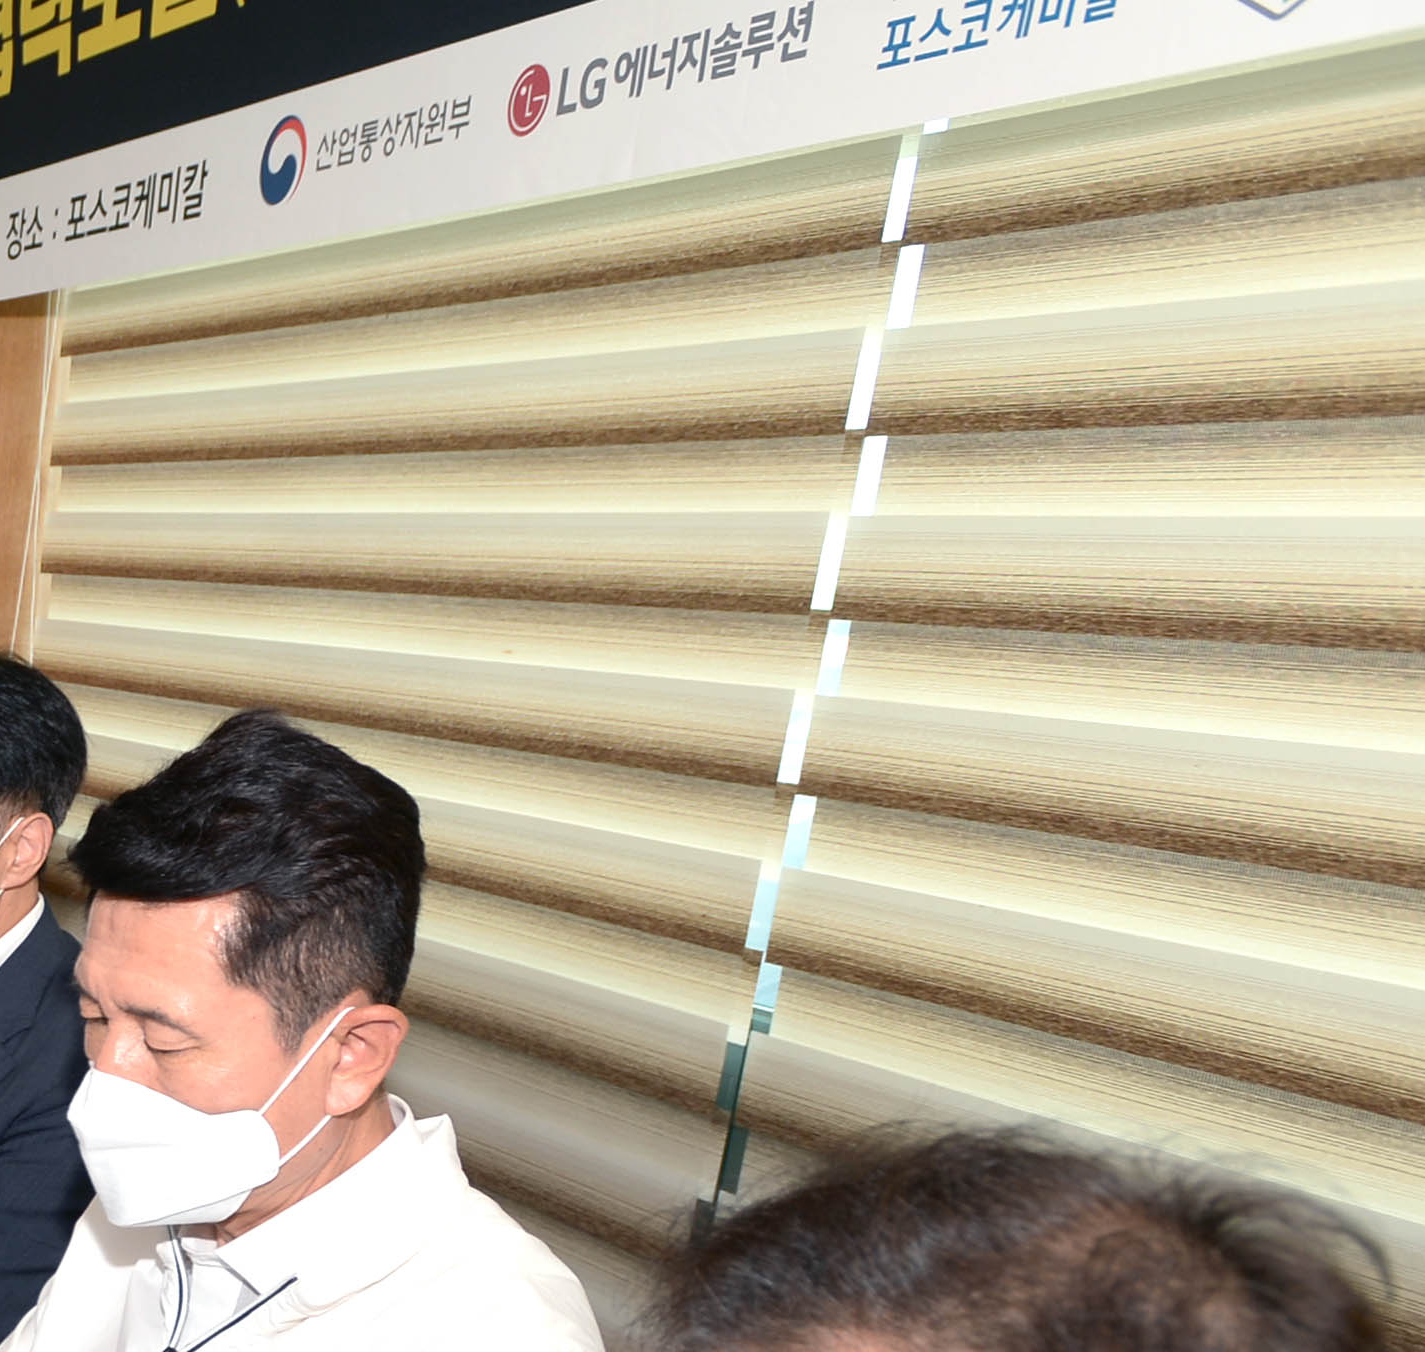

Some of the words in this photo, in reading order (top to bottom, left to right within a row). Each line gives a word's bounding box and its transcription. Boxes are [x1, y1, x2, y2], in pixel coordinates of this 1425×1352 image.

[556, 58, 607, 116] LG
[613, 1, 813, 99] 에너지솔루션
[315, 96, 472, 172] 산업통상자원부
[6, 209, 43, 260] 장소
[65, 160, 209, 244] 포스코케미칼
